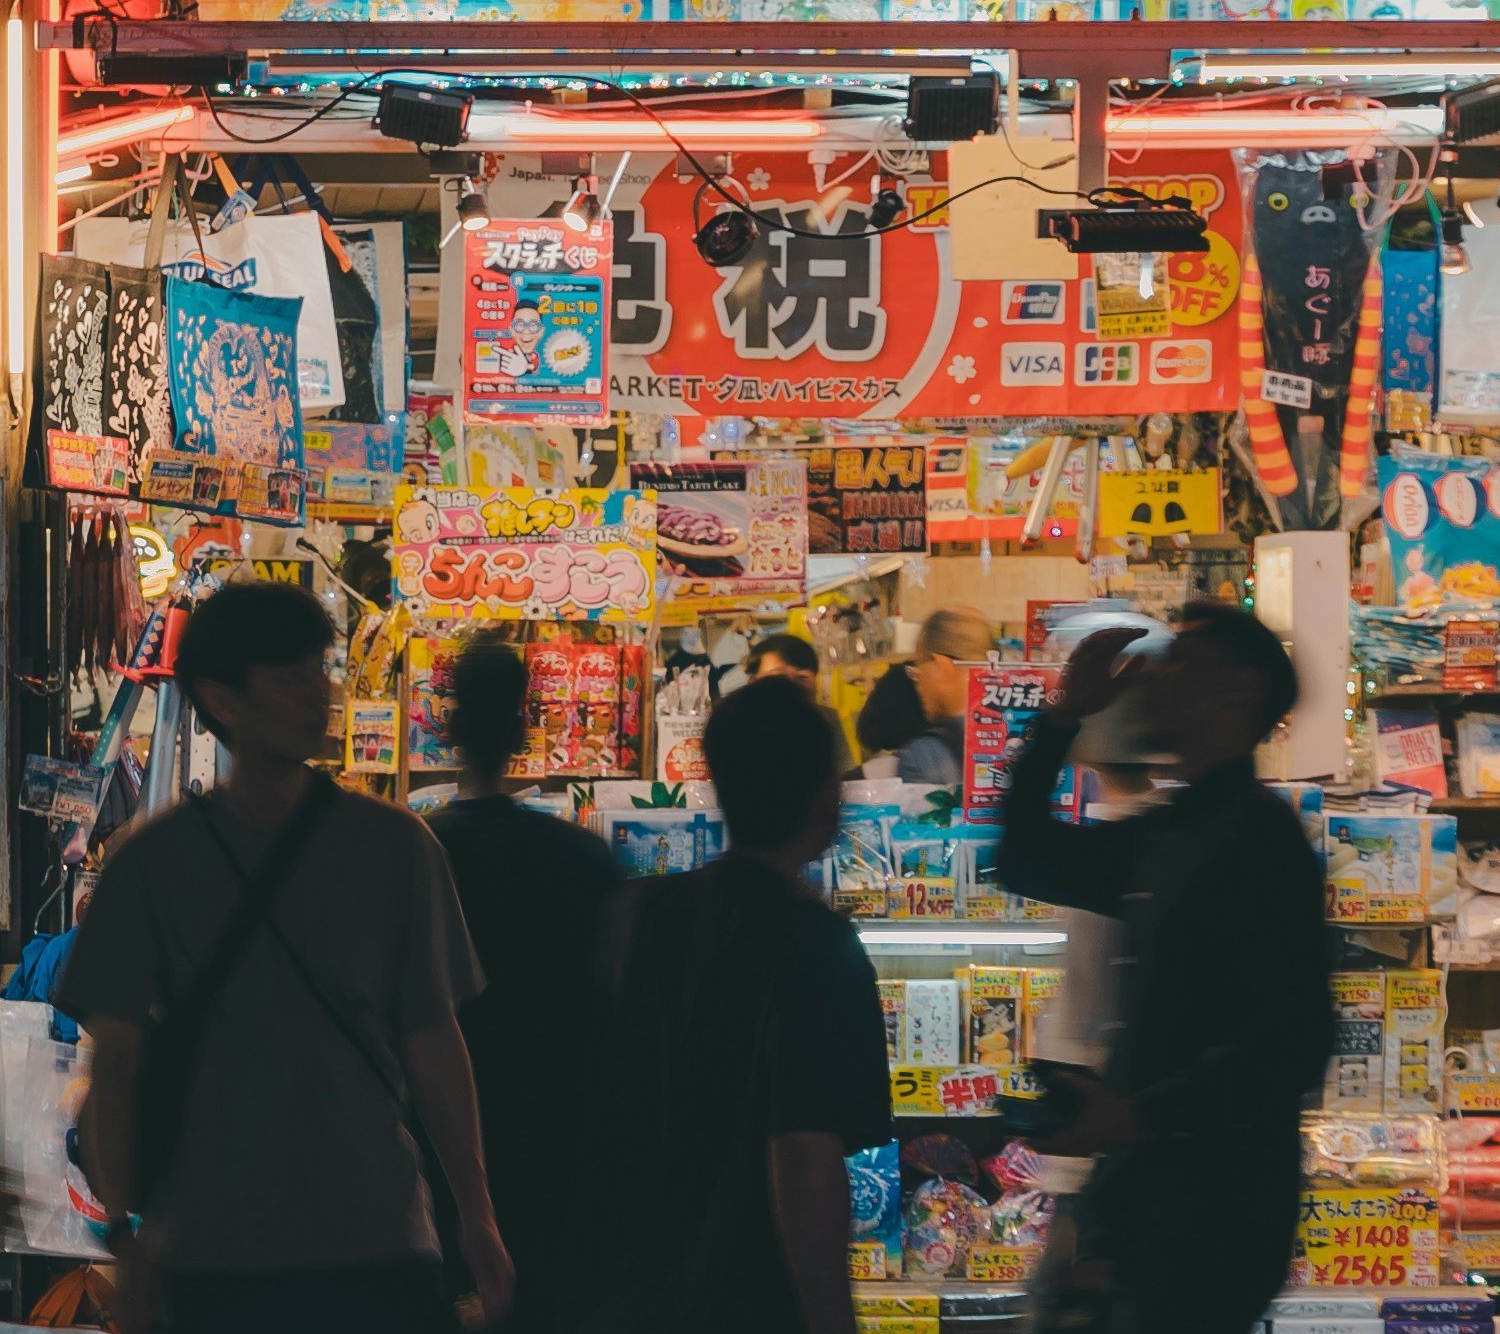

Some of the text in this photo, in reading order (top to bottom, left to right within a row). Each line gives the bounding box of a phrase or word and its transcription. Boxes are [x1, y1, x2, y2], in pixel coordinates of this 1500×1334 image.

[484, 241, 598, 269] スクラッチくじ
[1008, 355, 1063, 374] VISA
[1400, 727, 1438, 751] DRAFT
[1405, 748, 1439, 767] BEER
[1302, 1193, 1390, 1223] 大ちんすこう
[1334, 1225, 1410, 1248] ¥1408
[1315, 1255, 1407, 1287] ¥2565
